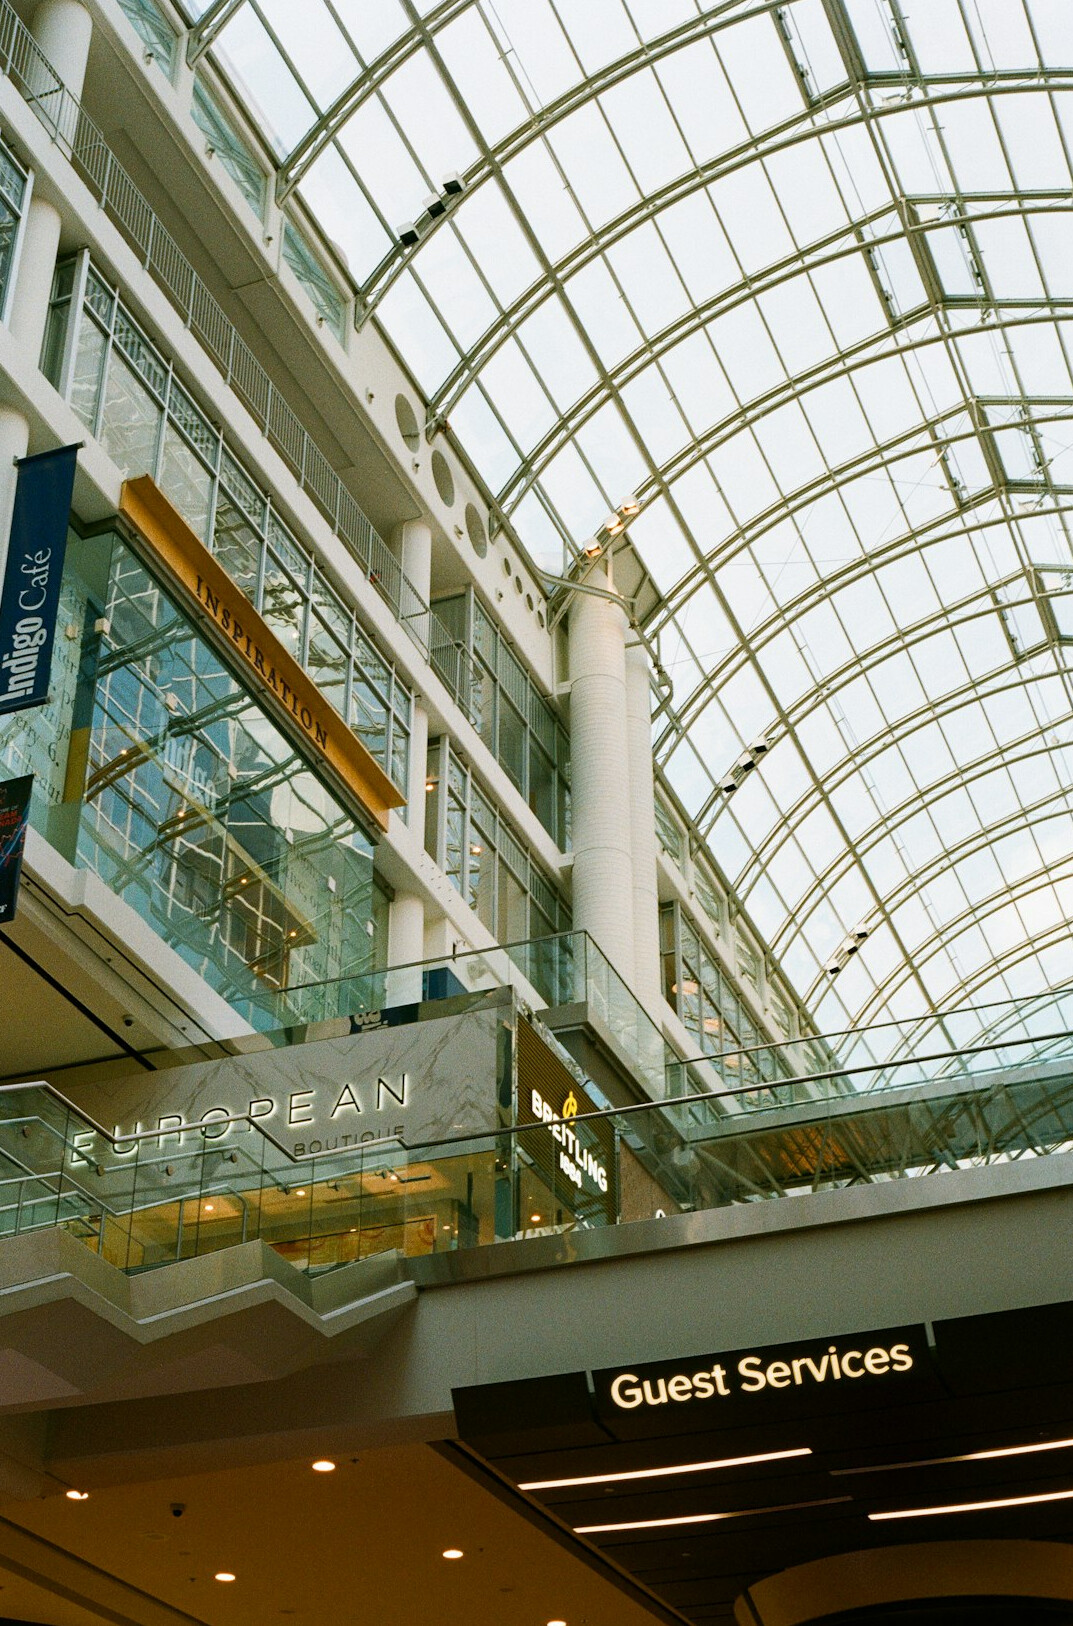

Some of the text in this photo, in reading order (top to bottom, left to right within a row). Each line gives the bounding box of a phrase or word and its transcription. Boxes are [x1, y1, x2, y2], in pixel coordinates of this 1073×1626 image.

[0, 547, 51, 702] Indigo Café
[195, 575, 328, 750] INSPIRATION
[70, 1072, 407, 1165] EUROPEAN
[294, 1125, 404, 1157] BOUTIQUE
[531, 1088, 608, 1193] BREITLING
[610, 1344, 914, 1409] Guest Services
